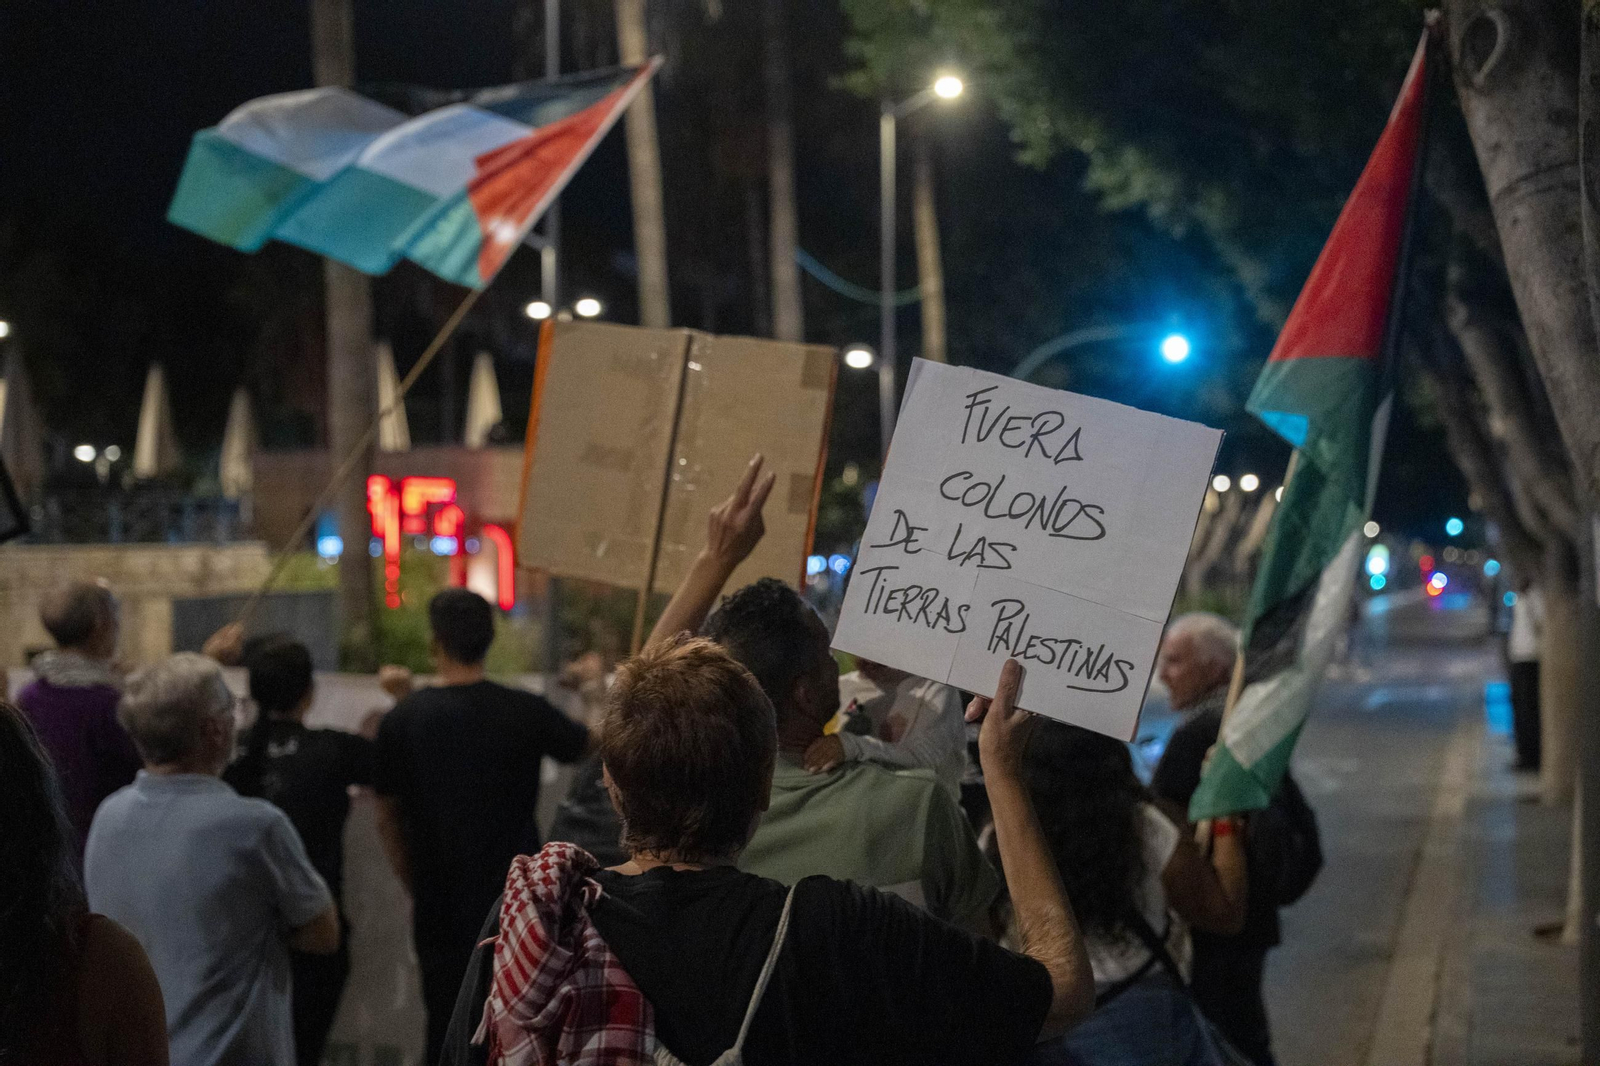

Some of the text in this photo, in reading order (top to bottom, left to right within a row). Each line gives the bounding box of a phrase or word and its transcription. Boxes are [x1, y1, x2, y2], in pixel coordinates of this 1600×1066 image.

[961, 385, 1084, 466] FUERA
[870, 509, 1018, 570] DE LAS
[939, 471, 1106, 541] COLONOS
